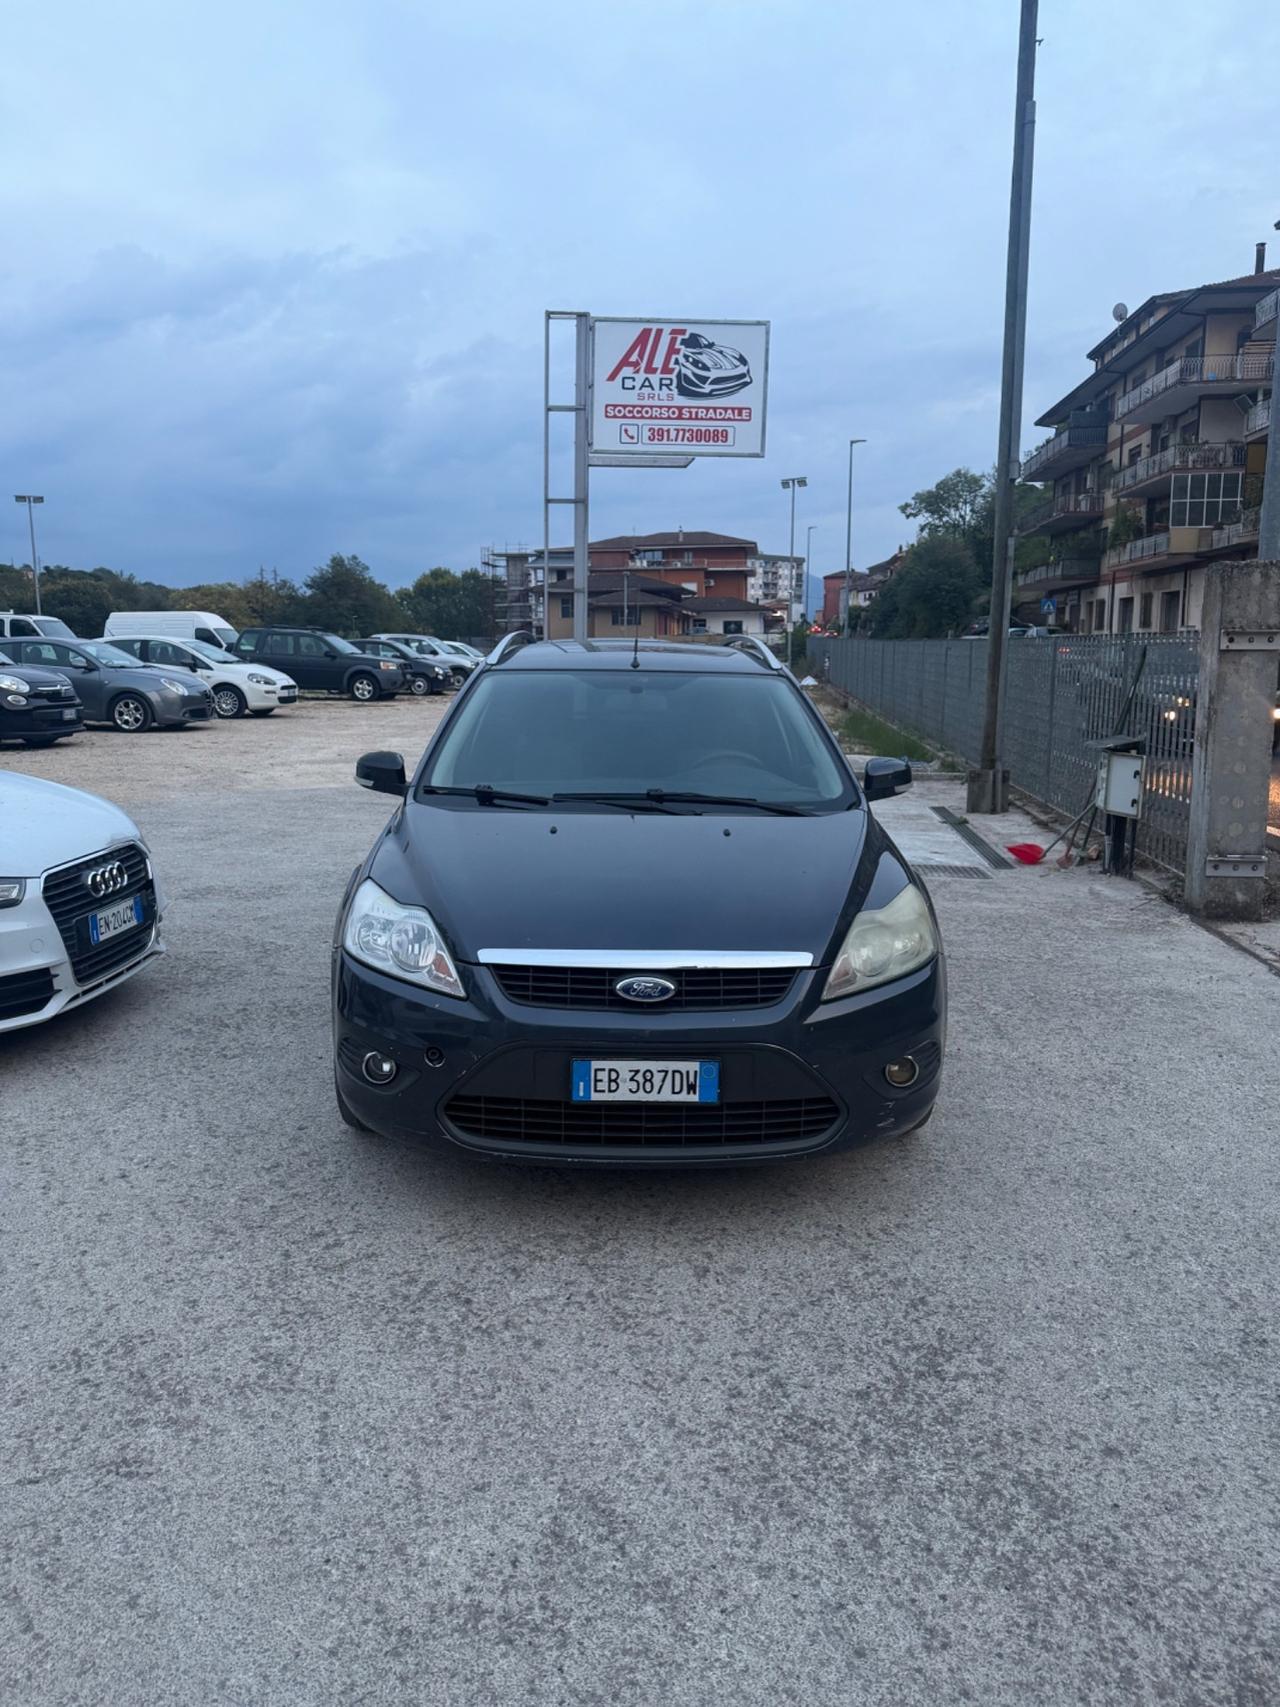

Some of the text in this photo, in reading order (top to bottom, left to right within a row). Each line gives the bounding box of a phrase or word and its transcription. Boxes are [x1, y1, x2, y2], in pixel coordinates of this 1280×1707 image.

[622, 376, 673, 391] CAR
[637, 392, 675, 401] SRLS
[606, 406, 750, 420] SOCCORSO STRADALE
[648, 427, 728, 443] 391.7730089
[630, 982, 663, 997] Ford
